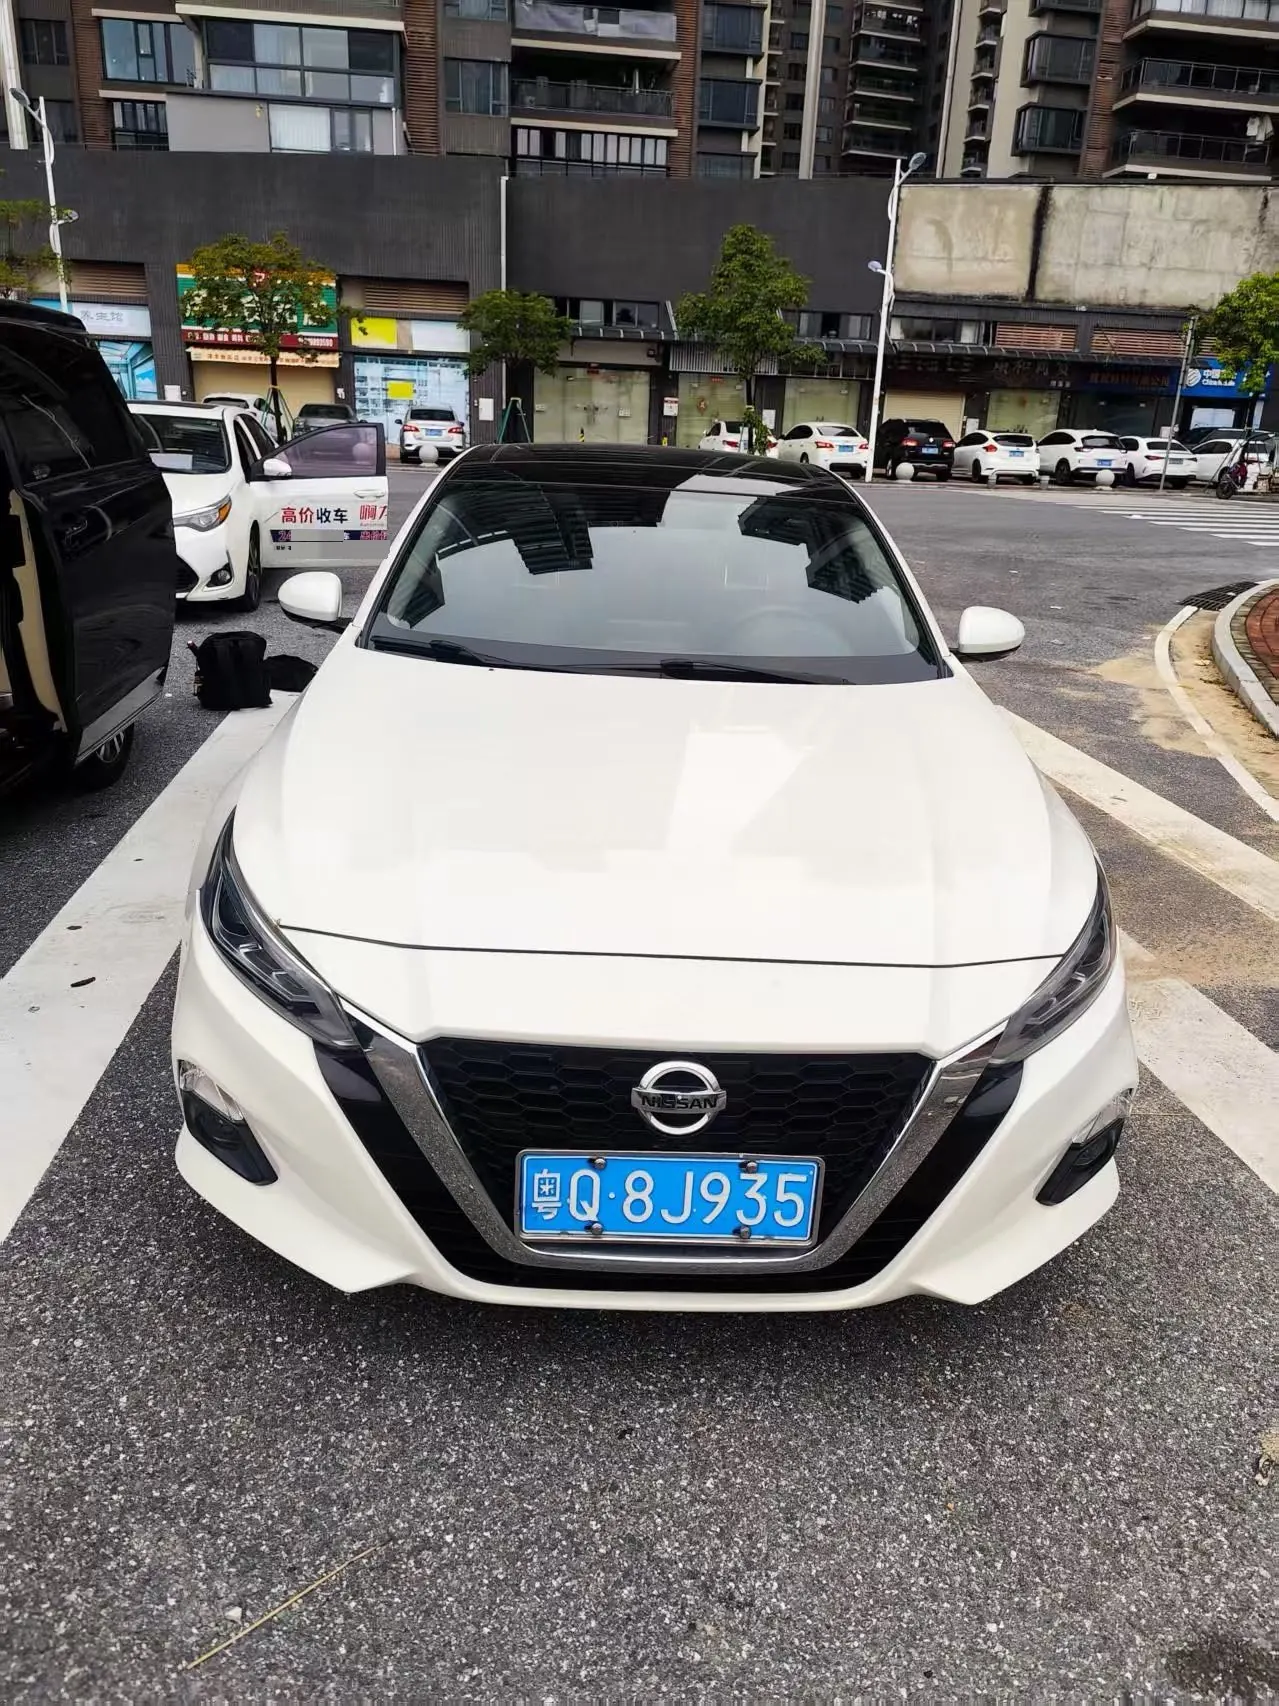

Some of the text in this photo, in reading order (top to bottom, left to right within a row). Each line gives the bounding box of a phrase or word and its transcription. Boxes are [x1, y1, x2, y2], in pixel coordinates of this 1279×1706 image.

[281, 507, 349, 524] 高价收车
[641, 1094, 718, 1110] NISSAN
